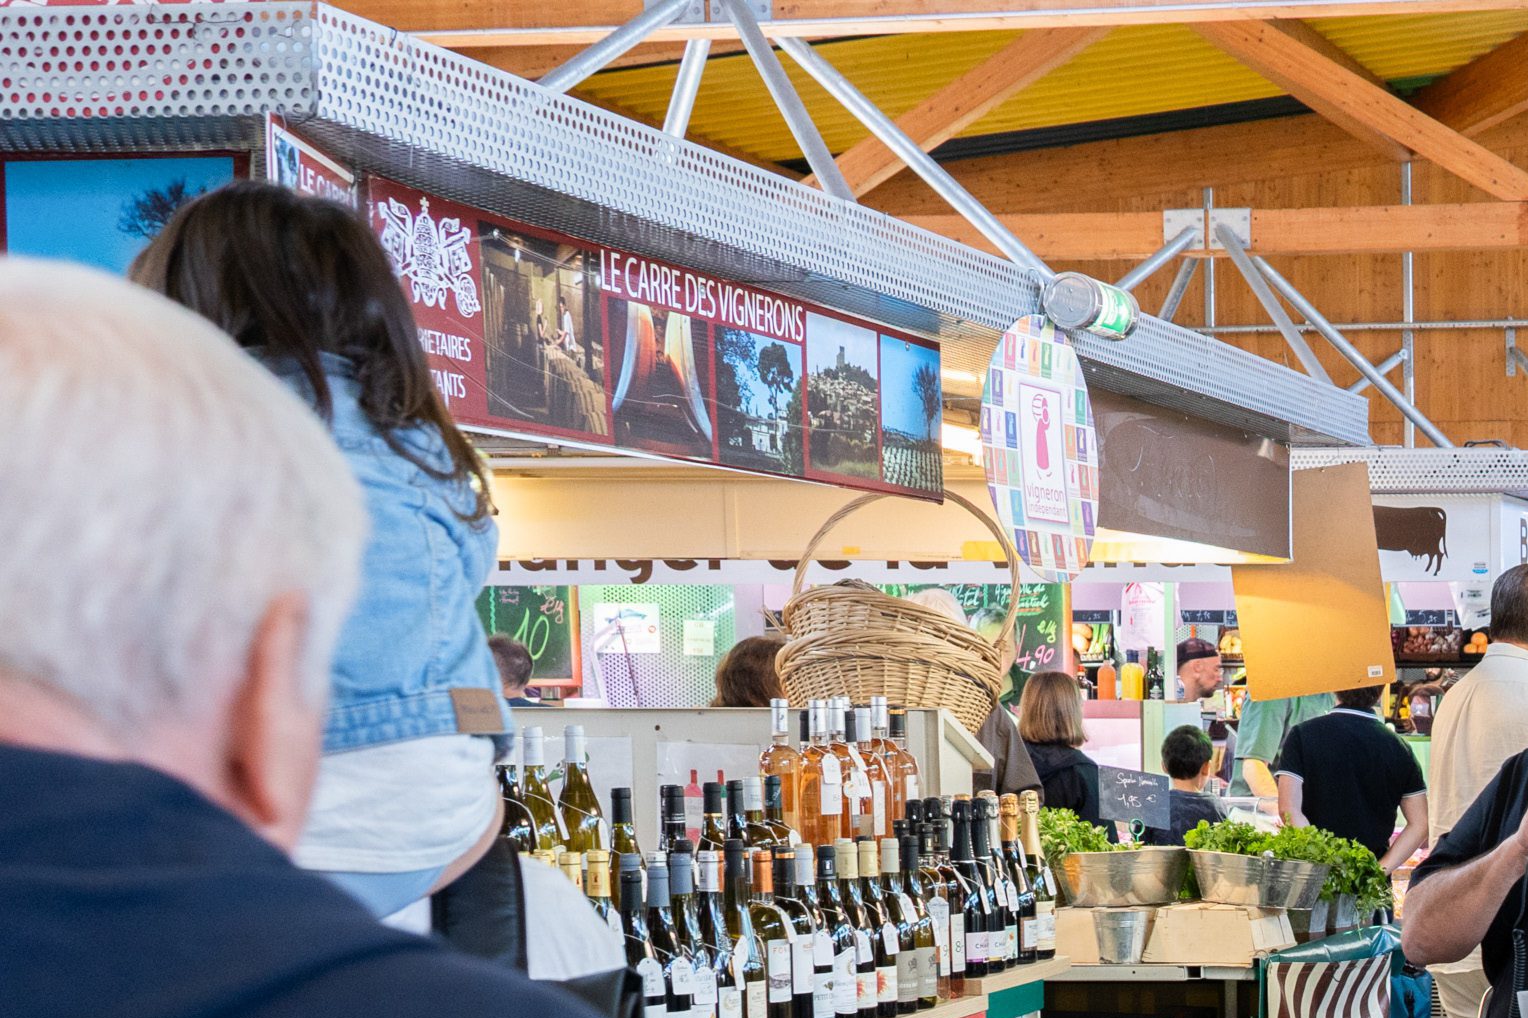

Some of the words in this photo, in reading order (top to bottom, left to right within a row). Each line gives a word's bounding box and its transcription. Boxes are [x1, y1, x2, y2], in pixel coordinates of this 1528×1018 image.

[601, 250, 622, 293] LE
[625, 257, 682, 310] CARRE
[685, 273, 716, 319] DES
[717, 281, 804, 342] VIGNERONS
[417, 328, 472, 362] RIETAIRES
[1026, 483, 1065, 504] vigneron
